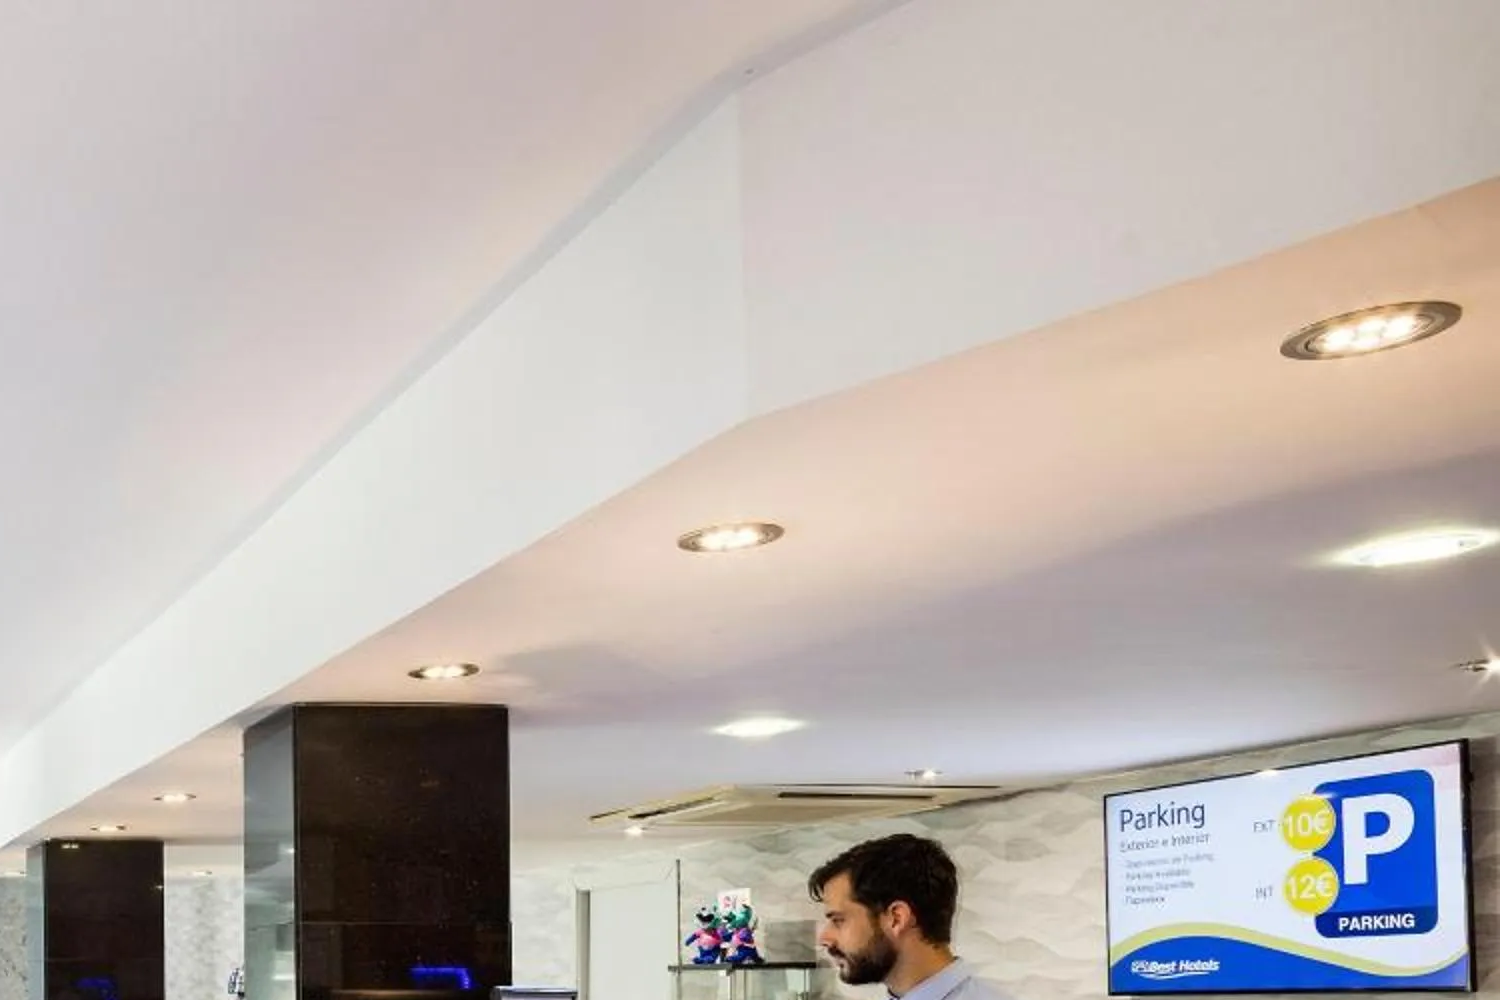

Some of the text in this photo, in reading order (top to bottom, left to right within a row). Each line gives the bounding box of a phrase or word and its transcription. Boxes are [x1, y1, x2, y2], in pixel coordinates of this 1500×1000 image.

[1119, 801, 1206, 833] Parking
[1285, 809, 1332, 839] 10€
[1119, 837, 1160, 853] Exterior
[1171, 832, 1212, 848] Interior
[1341, 792, 1415, 885] P
[1288, 870, 1334, 900] 12€
[1338, 913, 1416, 932] PARKING
[1150, 959, 1220, 974] Best Hotels
